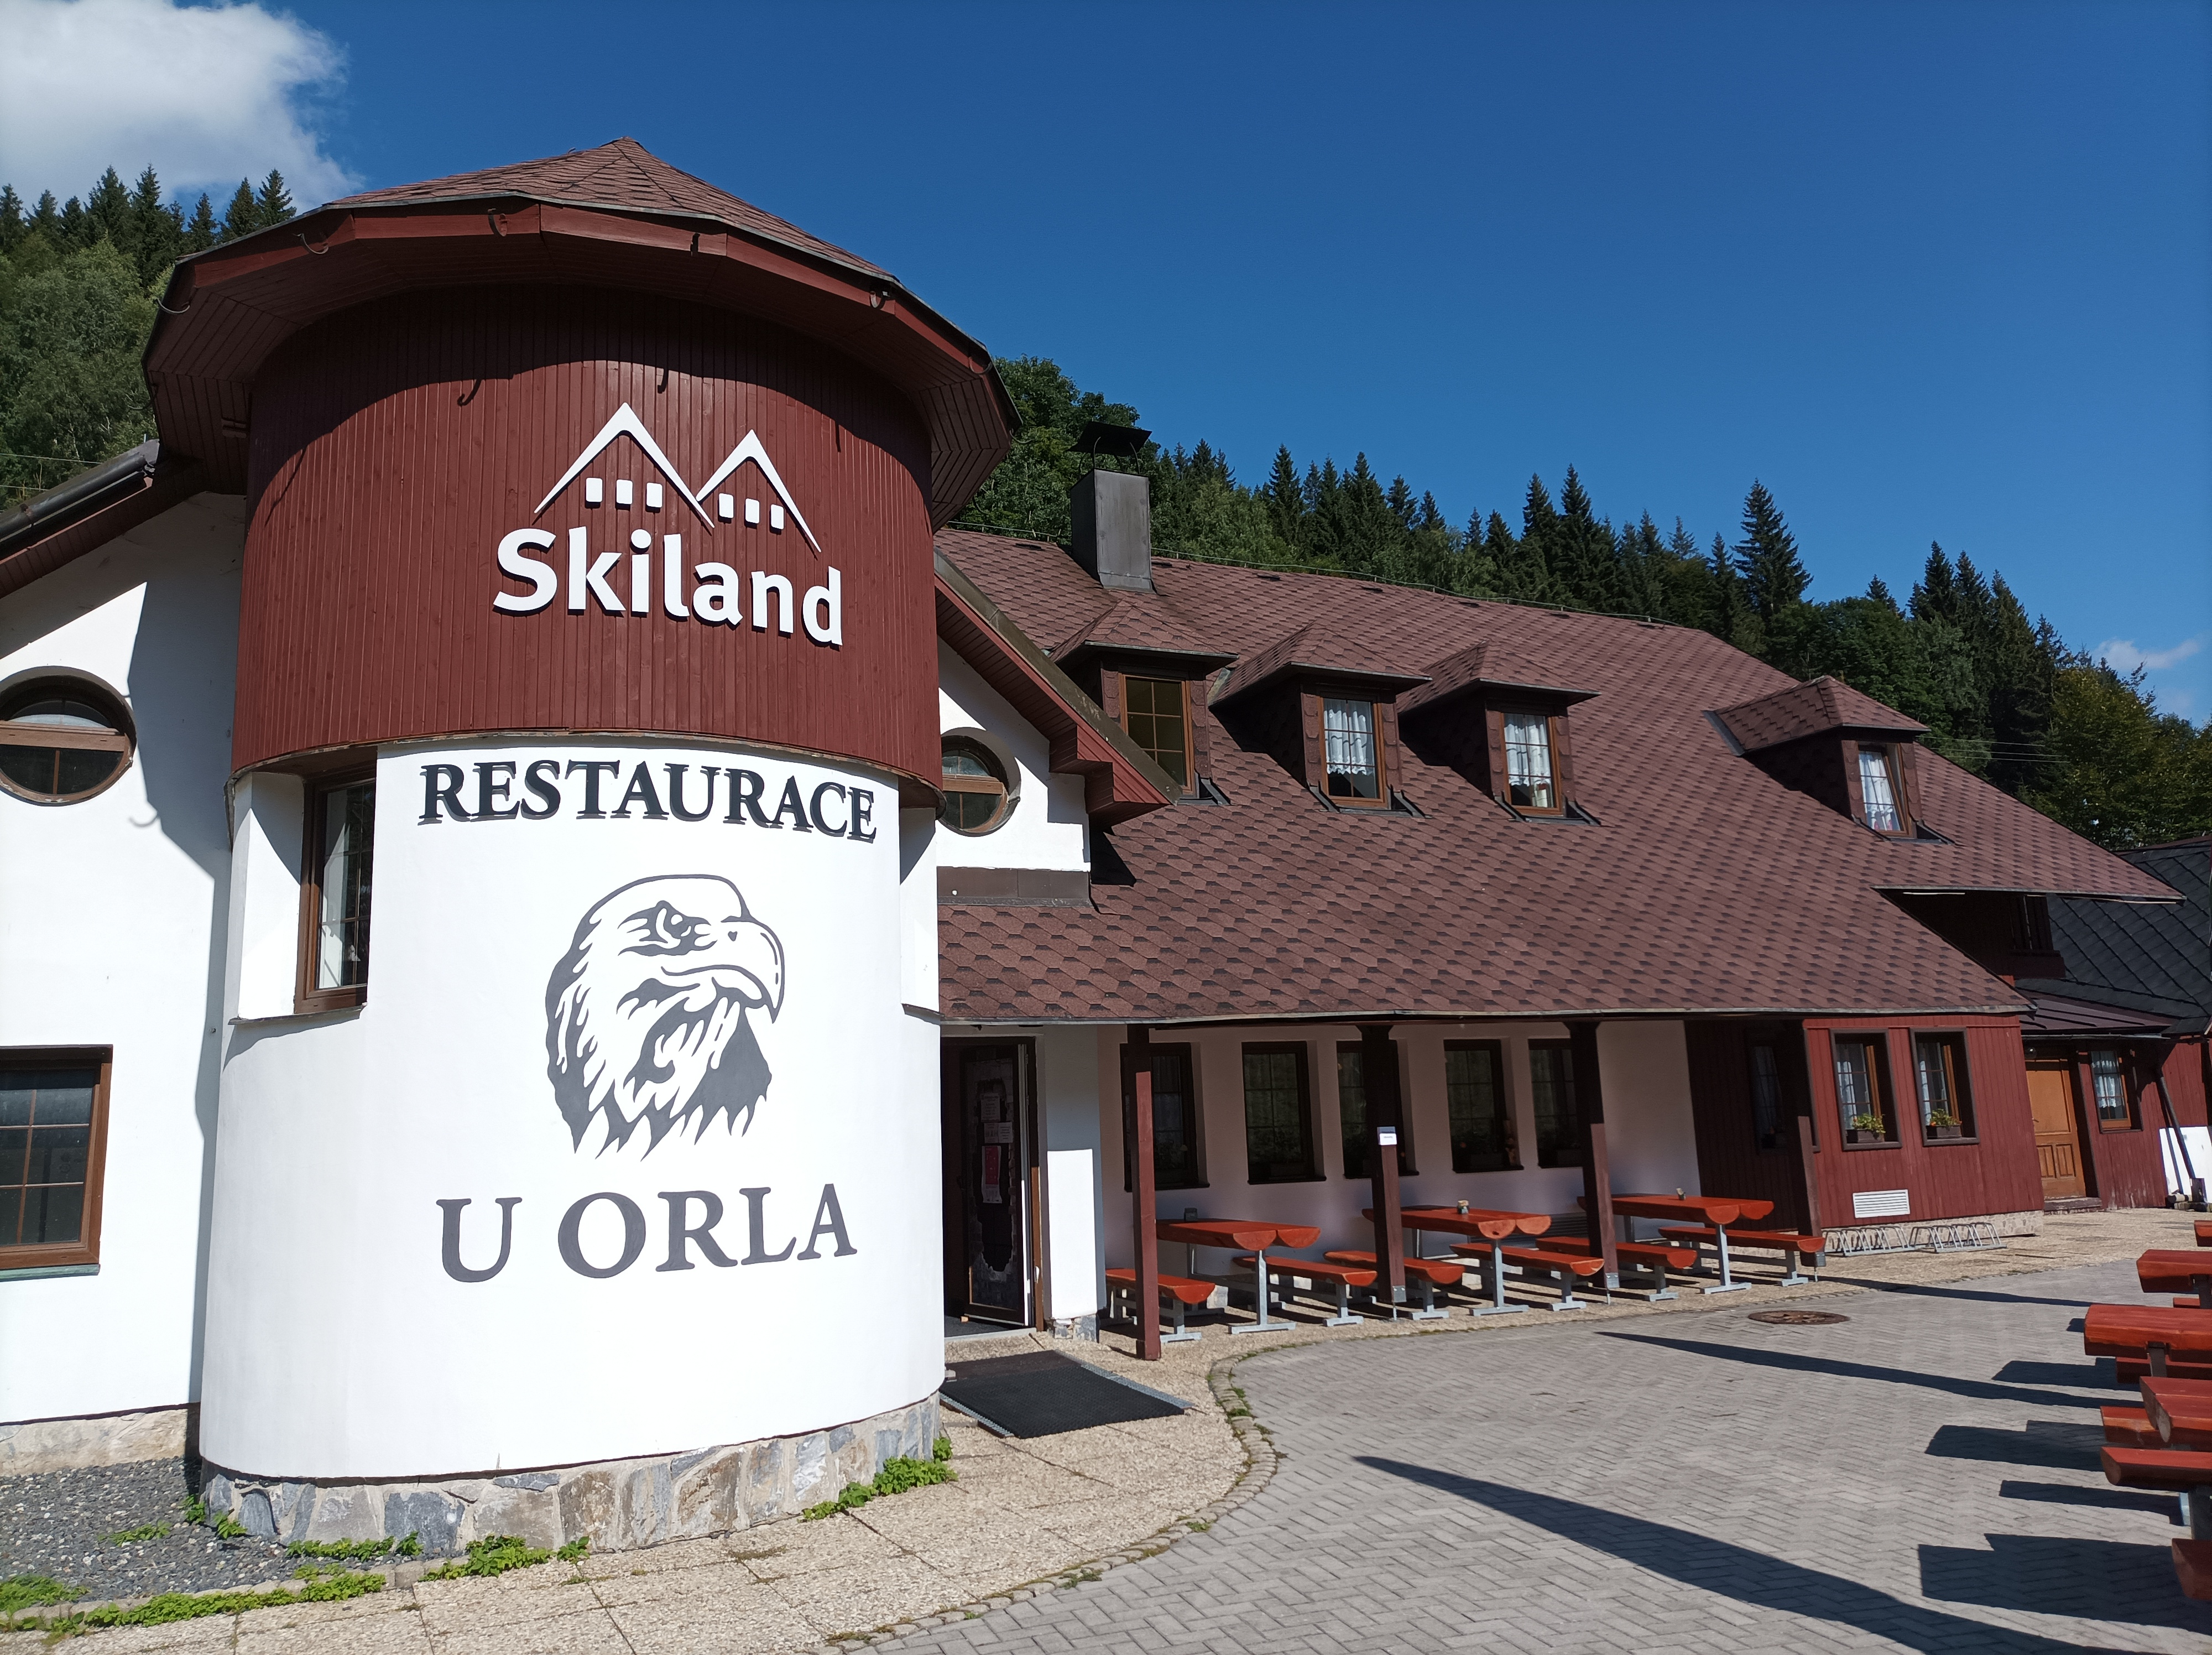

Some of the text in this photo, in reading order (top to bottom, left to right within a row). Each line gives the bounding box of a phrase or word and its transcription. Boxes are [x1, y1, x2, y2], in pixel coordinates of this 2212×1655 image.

[493, 526, 842, 646] Skiland
[419, 759, 877, 841] RESTAURACE
[436, 1183, 858, 1283] U ORLA
